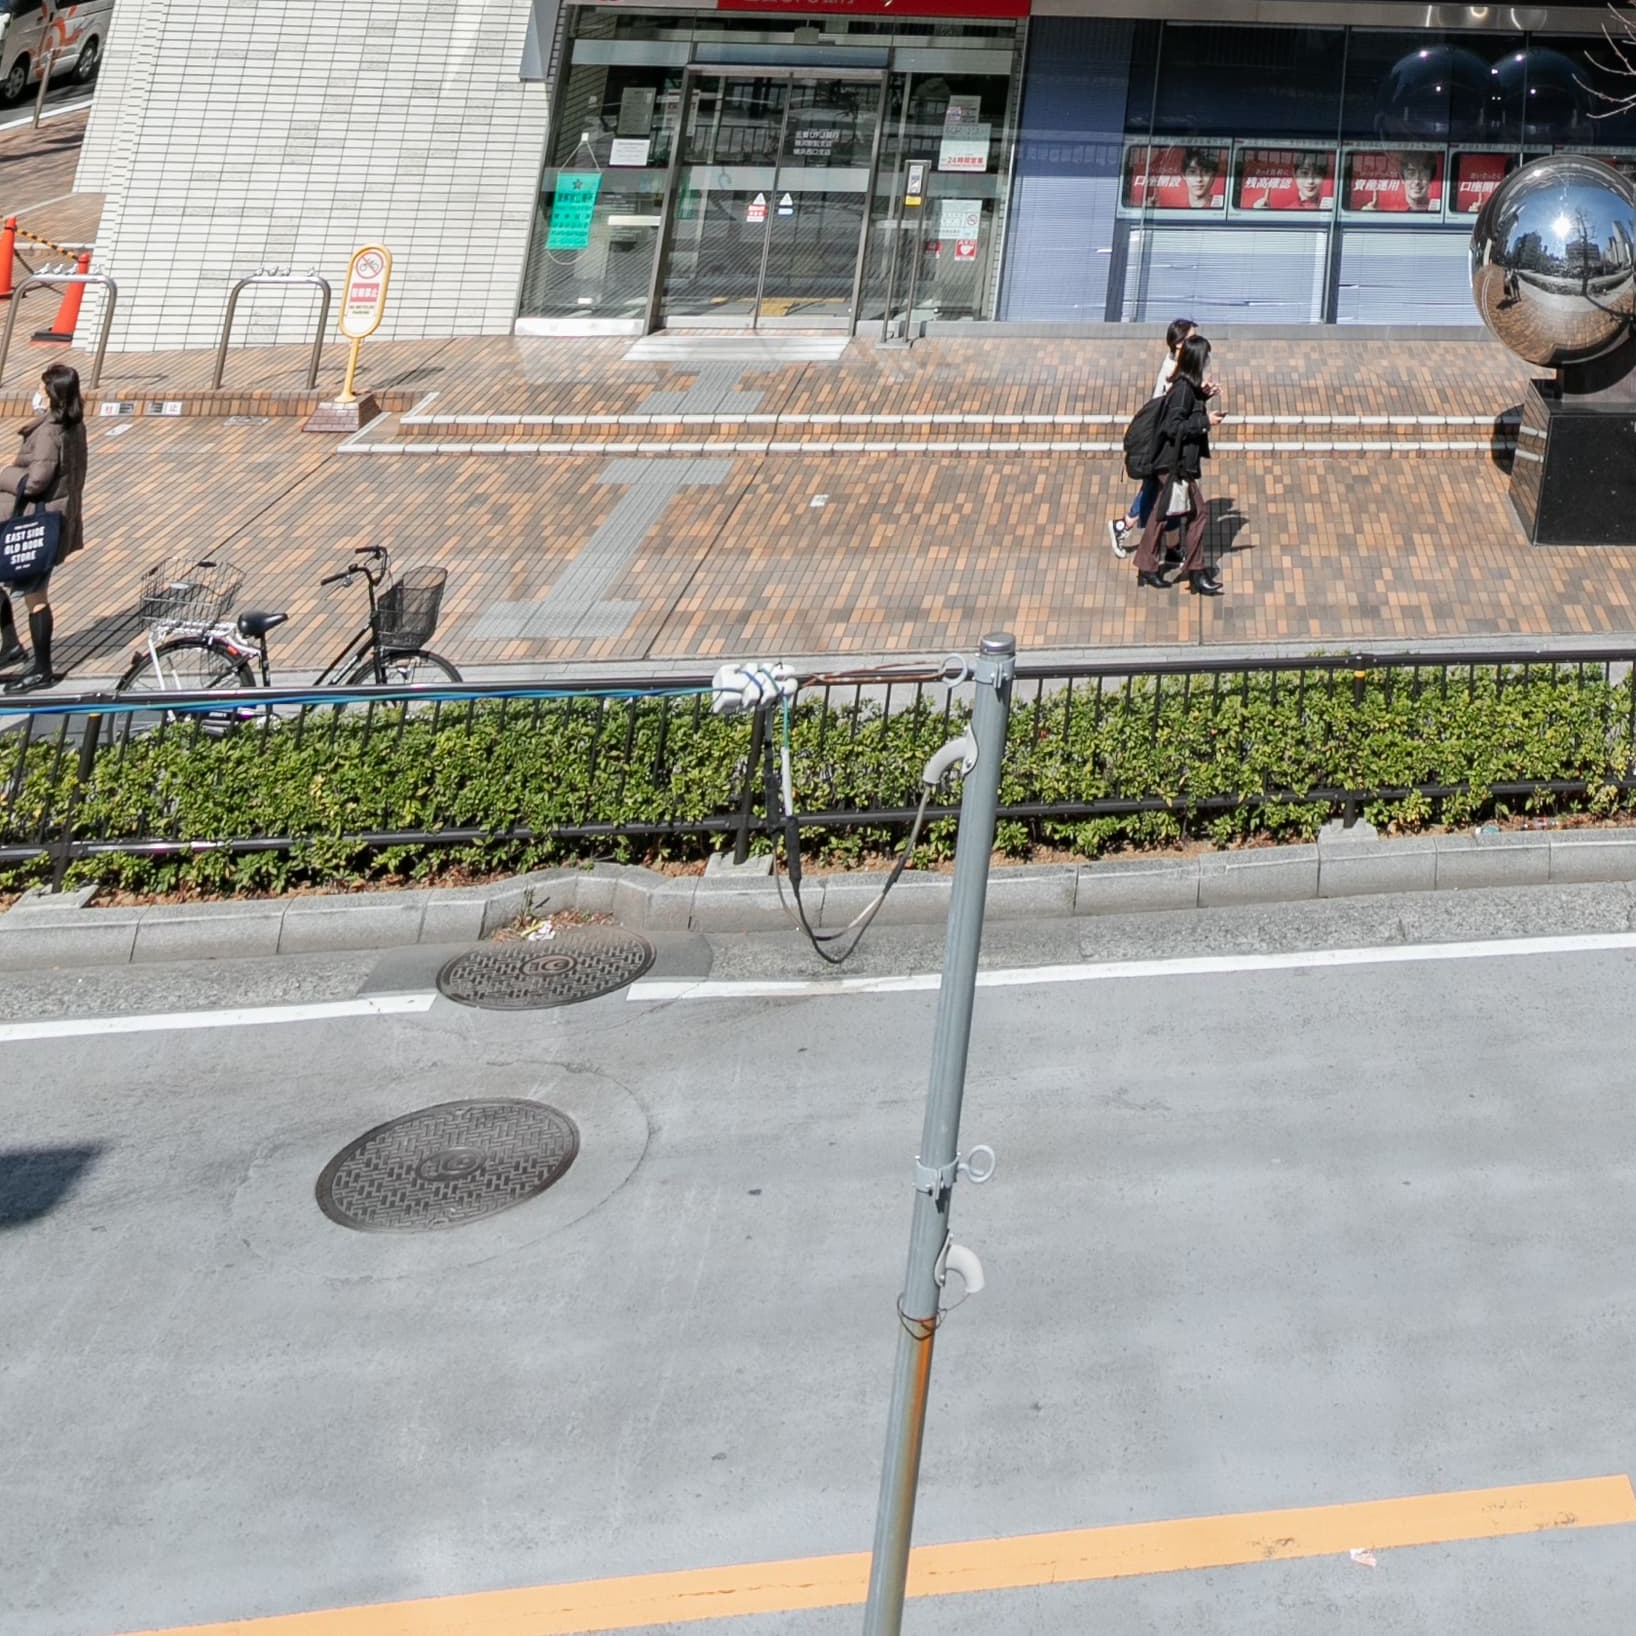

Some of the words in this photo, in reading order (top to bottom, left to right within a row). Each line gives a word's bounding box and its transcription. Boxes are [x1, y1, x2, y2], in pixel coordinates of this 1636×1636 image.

[1352, 178, 1400, 192] 資産運用
[5, 530, 26, 544] EAST
[27, 526, 45, 539] SIDE
[4, 543, 21, 555] OLD
[22, 538, 44, 551] BOOK
[10, 550, 37, 565] STORE
